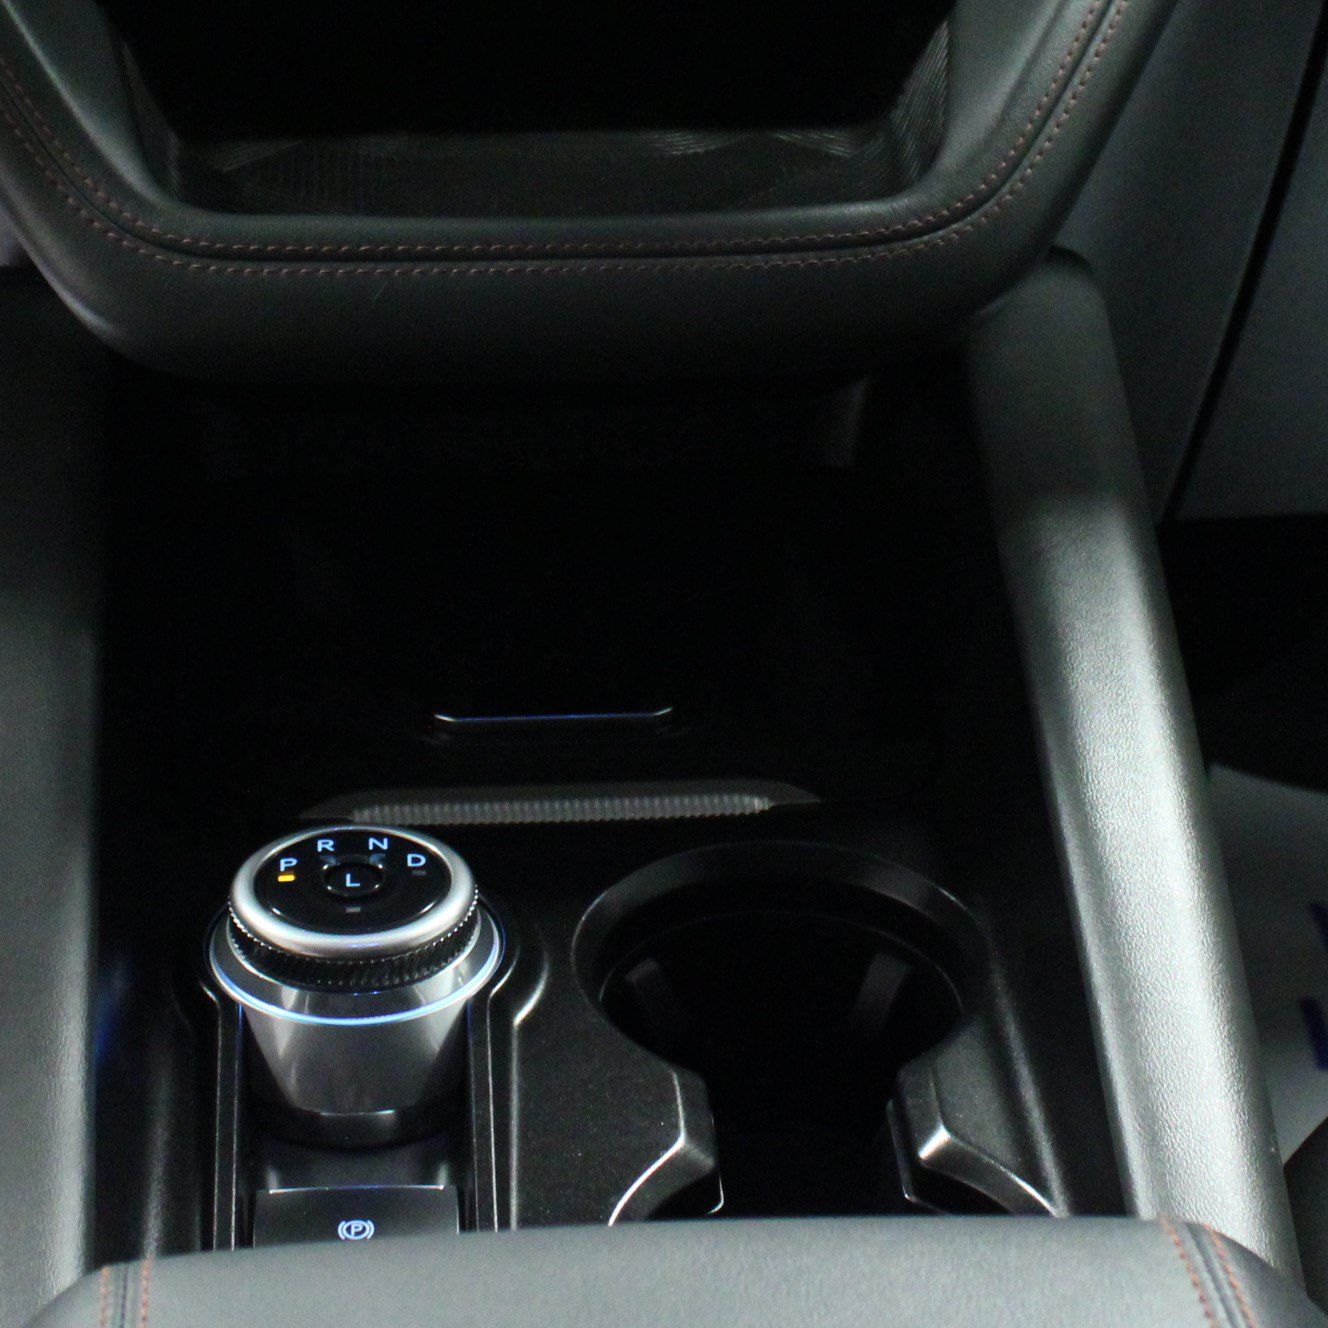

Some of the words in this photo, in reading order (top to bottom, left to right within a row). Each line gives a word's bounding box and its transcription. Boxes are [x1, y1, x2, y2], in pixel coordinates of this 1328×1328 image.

[279, 858, 298, 872] P
[317, 839, 335, 852] R
[368, 837, 388, 851] N
[407, 853, 426, 868] D
[345, 873, 361, 888] L
